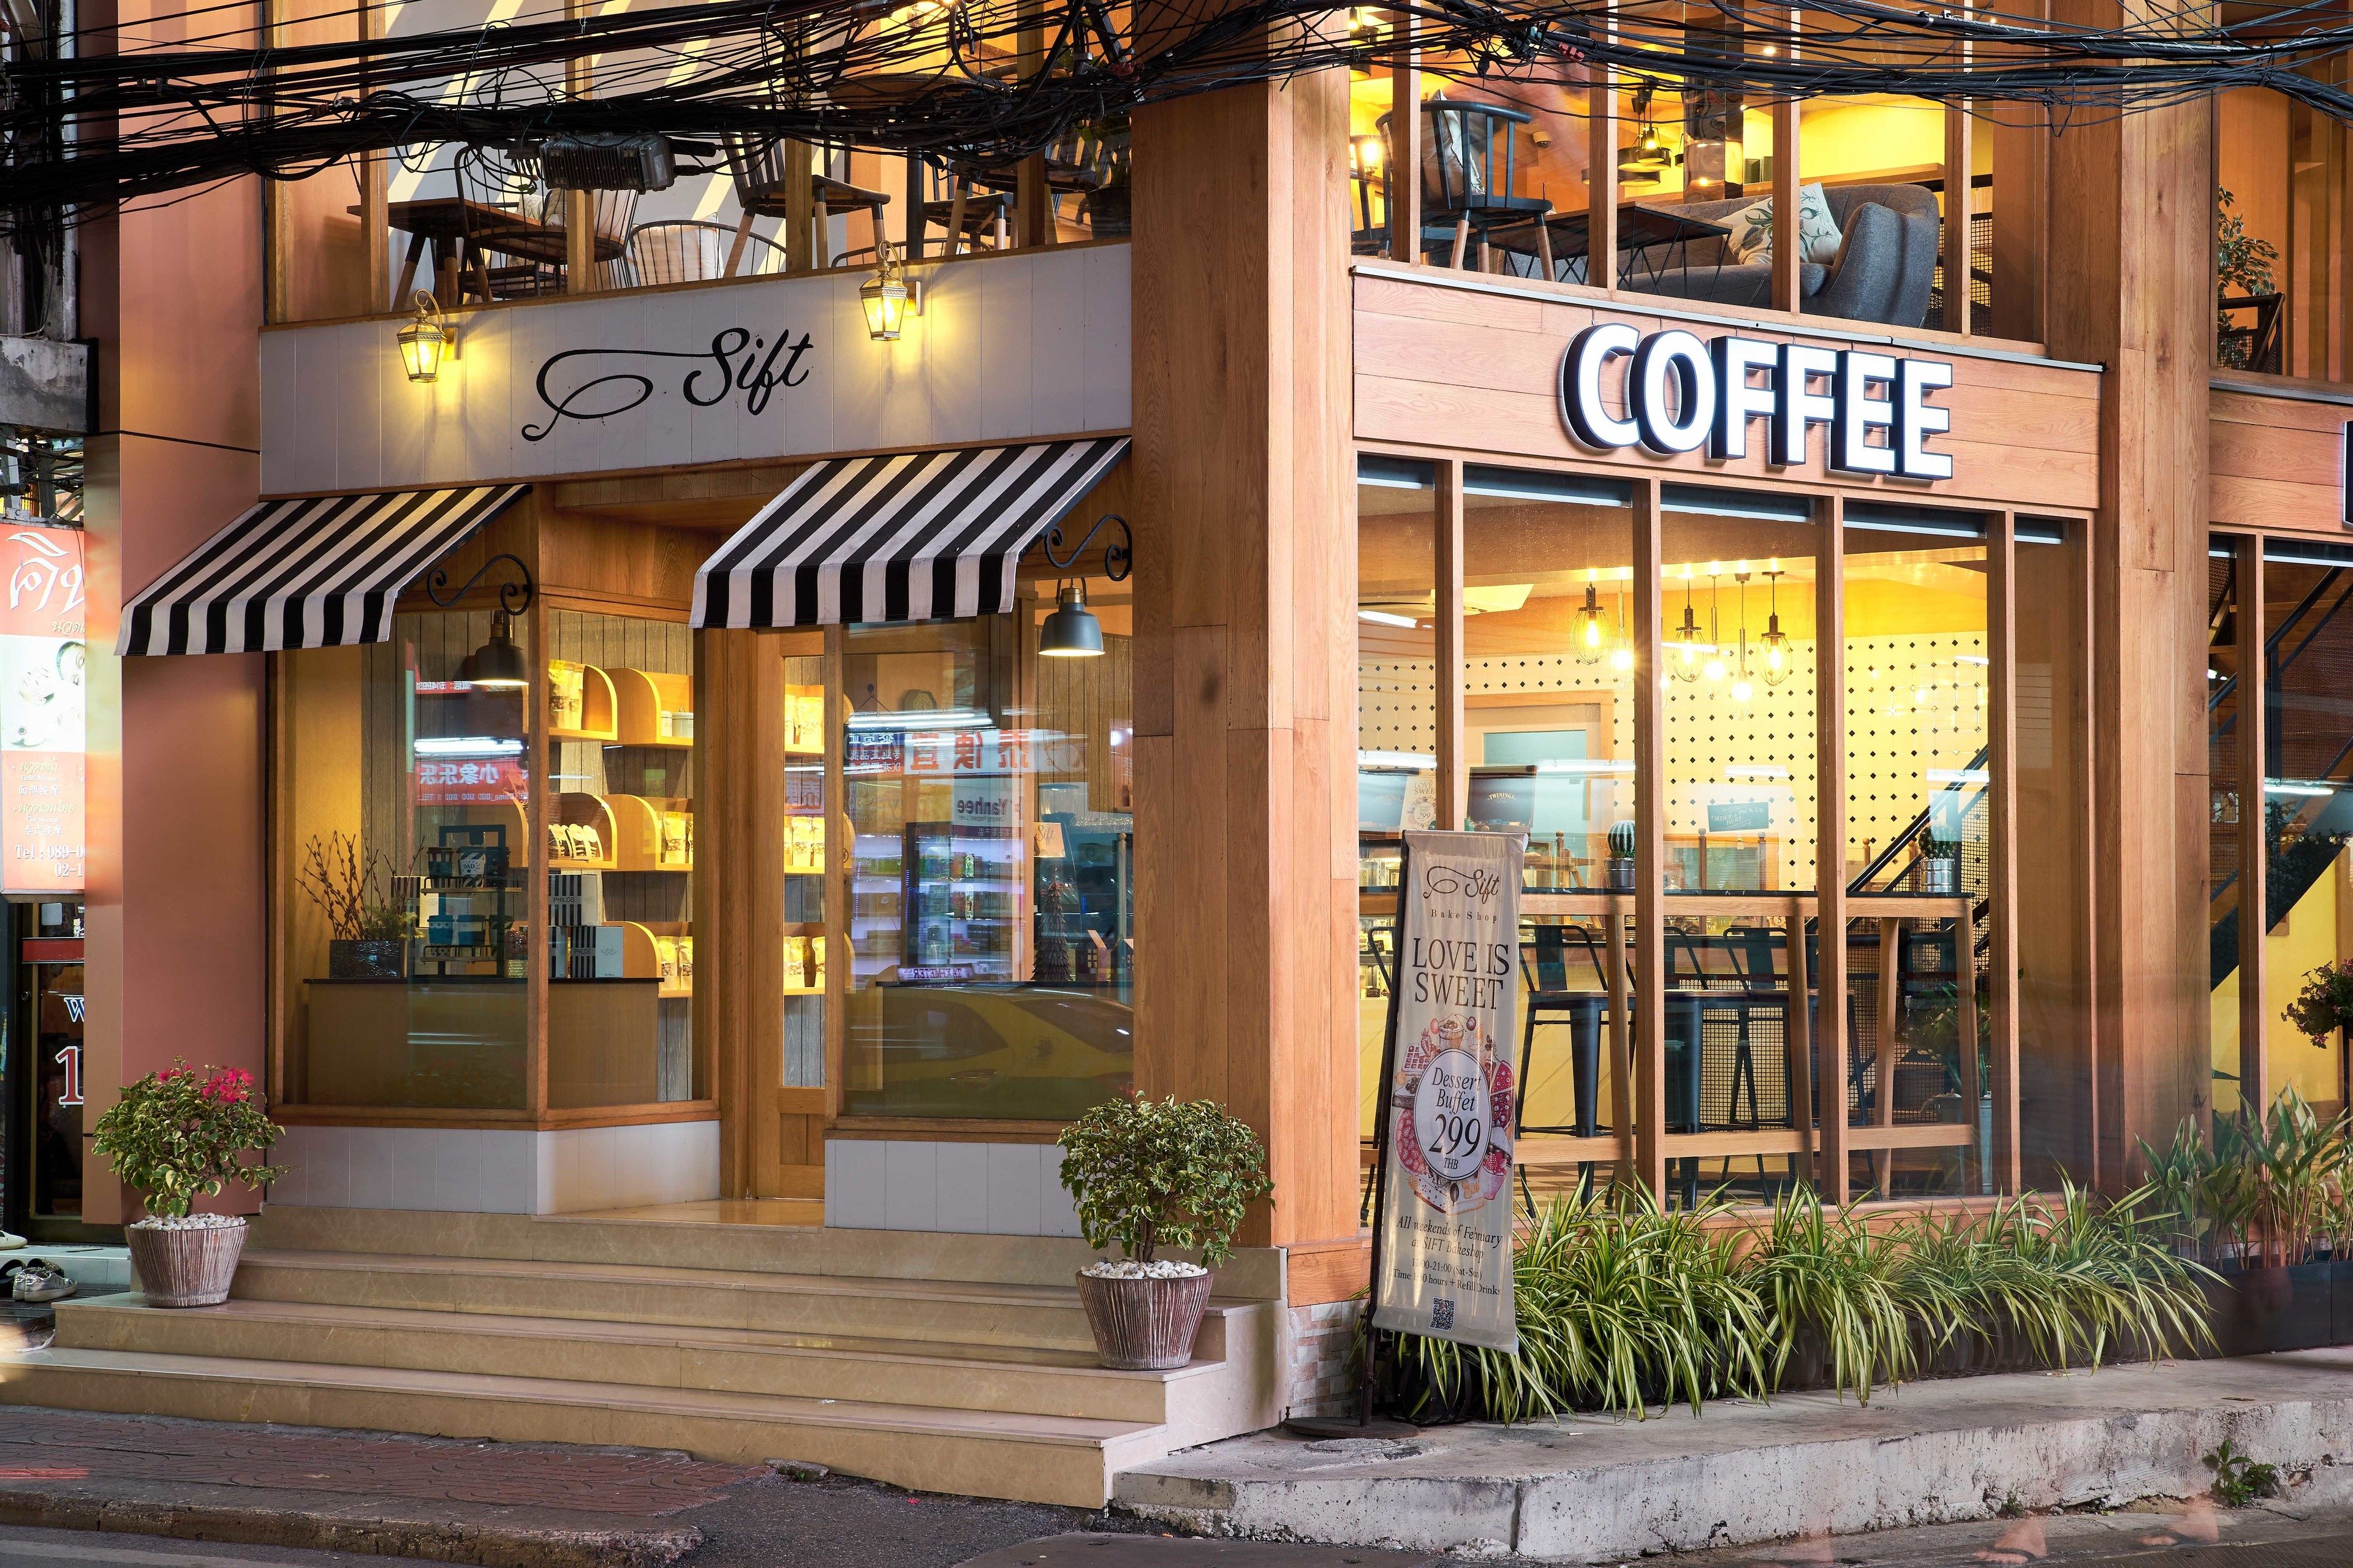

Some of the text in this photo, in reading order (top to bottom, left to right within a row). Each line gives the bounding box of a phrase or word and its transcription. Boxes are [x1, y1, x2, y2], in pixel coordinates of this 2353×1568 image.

[1563, 323, 1953, 480] COFFEE
[1726, 816, 1744, 825] HERE
[1738, 806, 1755, 816] PICK
[1034, 825, 1055, 846] Sift
[15, 844, 35, 859] Tel
[1431, 909, 1498, 924] Bake Shop
[1412, 937, 1510, 975] LOVE IS
[1415, 971, 1504, 1010] SWEET
[1431, 1067, 1482, 1091] Dessert
[1436, 1088, 1476, 1115] Buffet
[1428, 1113, 1482, 1157] 299
[1443, 1157, 1459, 1170] THB
[1396, 1216, 1503, 1249] All weekends of February
[1423, 1237, 1445, 1251] SIFT
[1446, 1241, 1484, 1263] Bakeshop
[1393, 1268, 1411, 1280] Time
[1428, 1274, 1448, 1287] hours
[1457, 1279, 1476, 1292] Refill
[1477, 1282, 1502, 1295] Drinks
[1453, 1265, 1483, 1281] (Sat-Sun)
